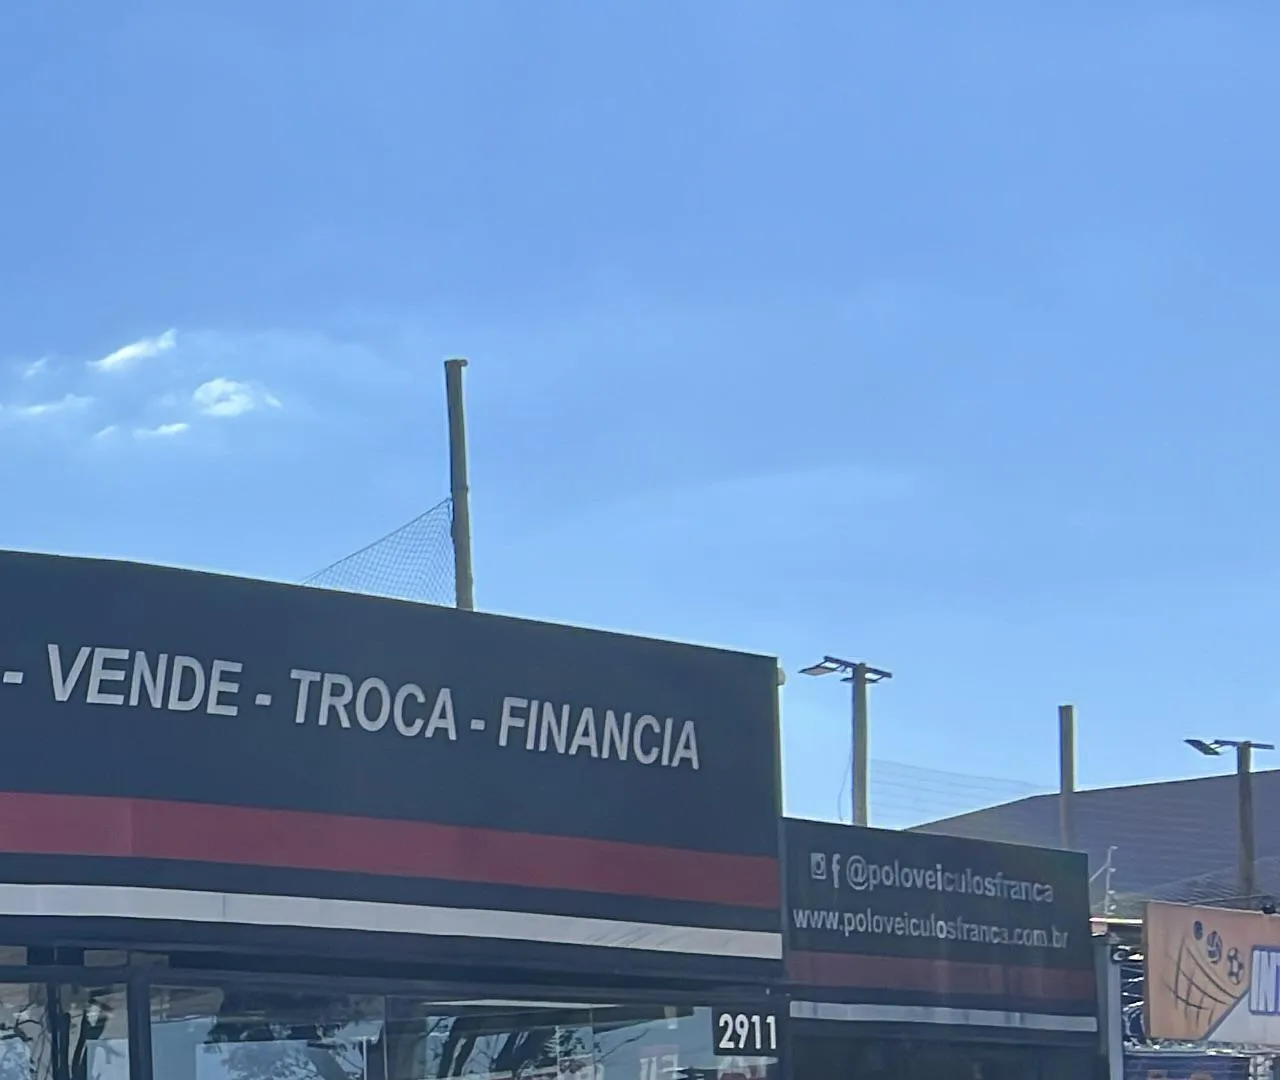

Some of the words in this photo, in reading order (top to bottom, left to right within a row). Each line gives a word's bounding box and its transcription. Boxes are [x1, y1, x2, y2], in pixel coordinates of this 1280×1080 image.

[47, 643, 244, 717] VENDE
[290, 668, 458, 742] TROCA
[498, 696, 700, 770] FINANCIA
[846, 855, 1054, 903] @poloveiculosfranca
[792, 907, 1069, 949] www.poloveiculosfranca.com.br
[718, 1012, 777, 1050] 2911
